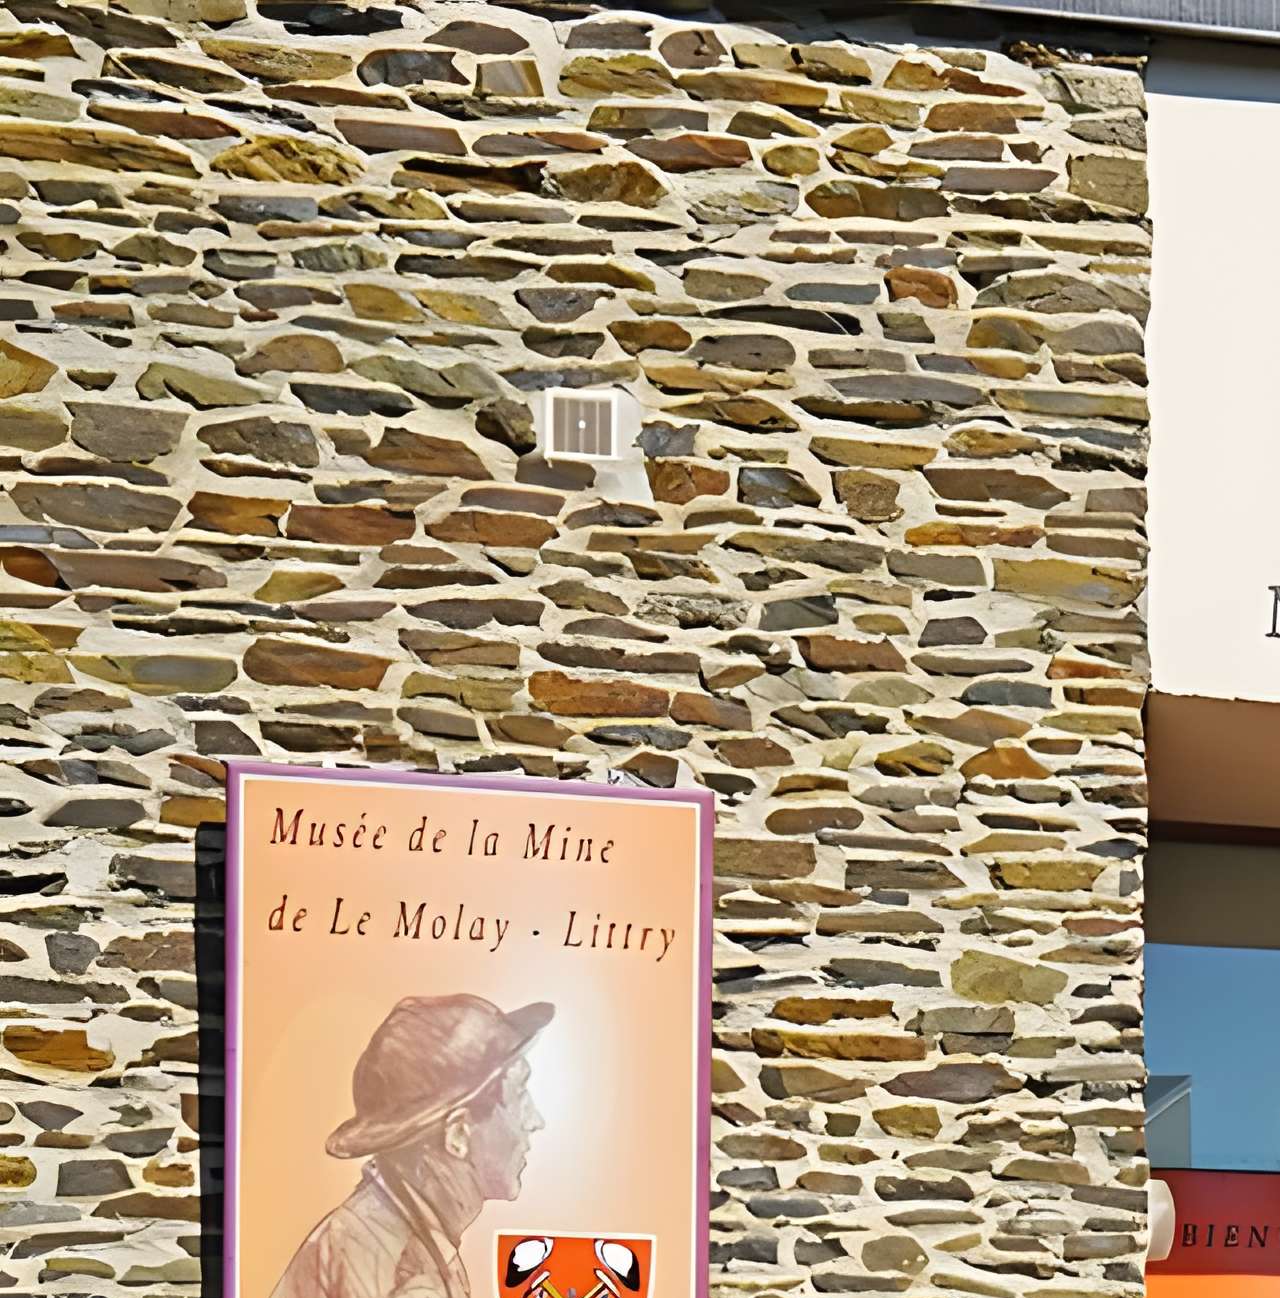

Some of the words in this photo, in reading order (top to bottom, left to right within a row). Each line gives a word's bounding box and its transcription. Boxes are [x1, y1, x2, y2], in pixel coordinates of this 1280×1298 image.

[269, 807, 387, 850] Musée
[408, 815, 447, 853] de
[467, 818, 499, 857] la
[523, 822, 615, 864] Mine
[268, 894, 307, 933] de
[329, 897, 371, 936] Le
[392, 900, 510, 953] Molay
[563, 910, 676, 963] Littry
